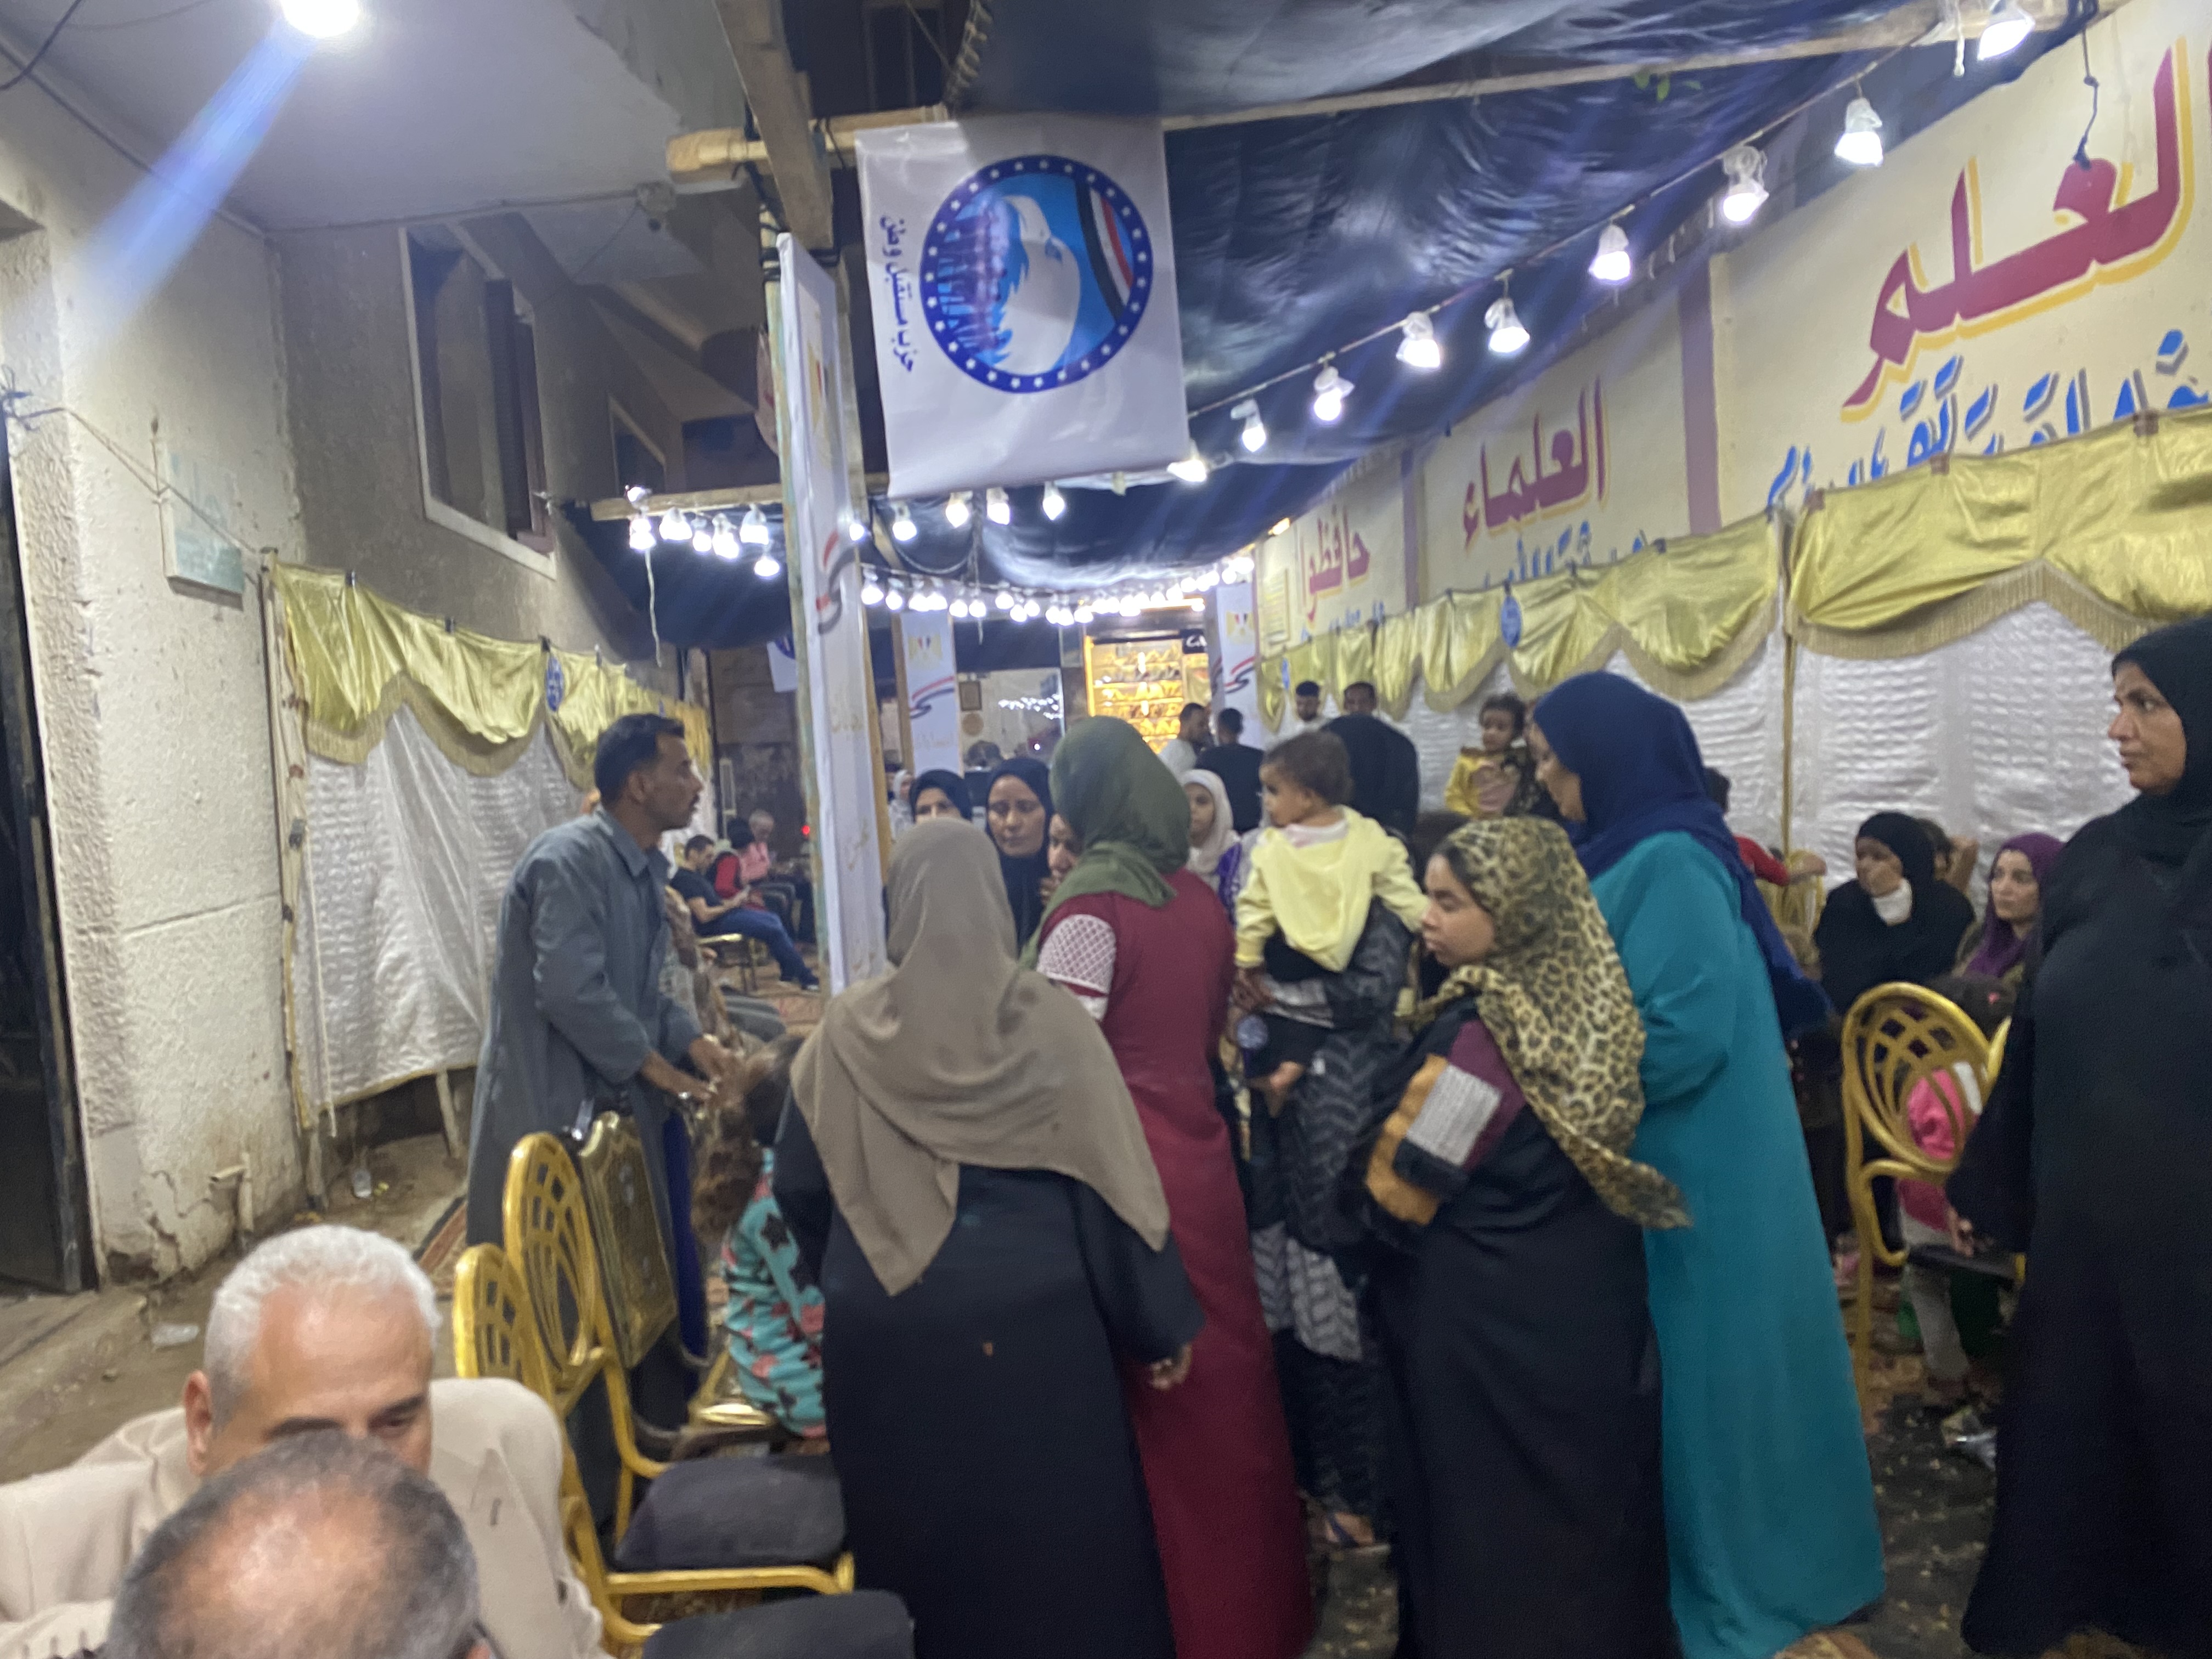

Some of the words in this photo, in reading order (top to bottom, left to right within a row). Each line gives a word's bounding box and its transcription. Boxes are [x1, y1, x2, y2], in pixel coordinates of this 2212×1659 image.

[879, 215, 906, 256] وطن
[1841, 38, 2212, 420] لعلم
[884, 262, 913, 325] مستقبل
[891, 330, 917, 372] حزب
[1463, 376, 1606, 550] العلماء
